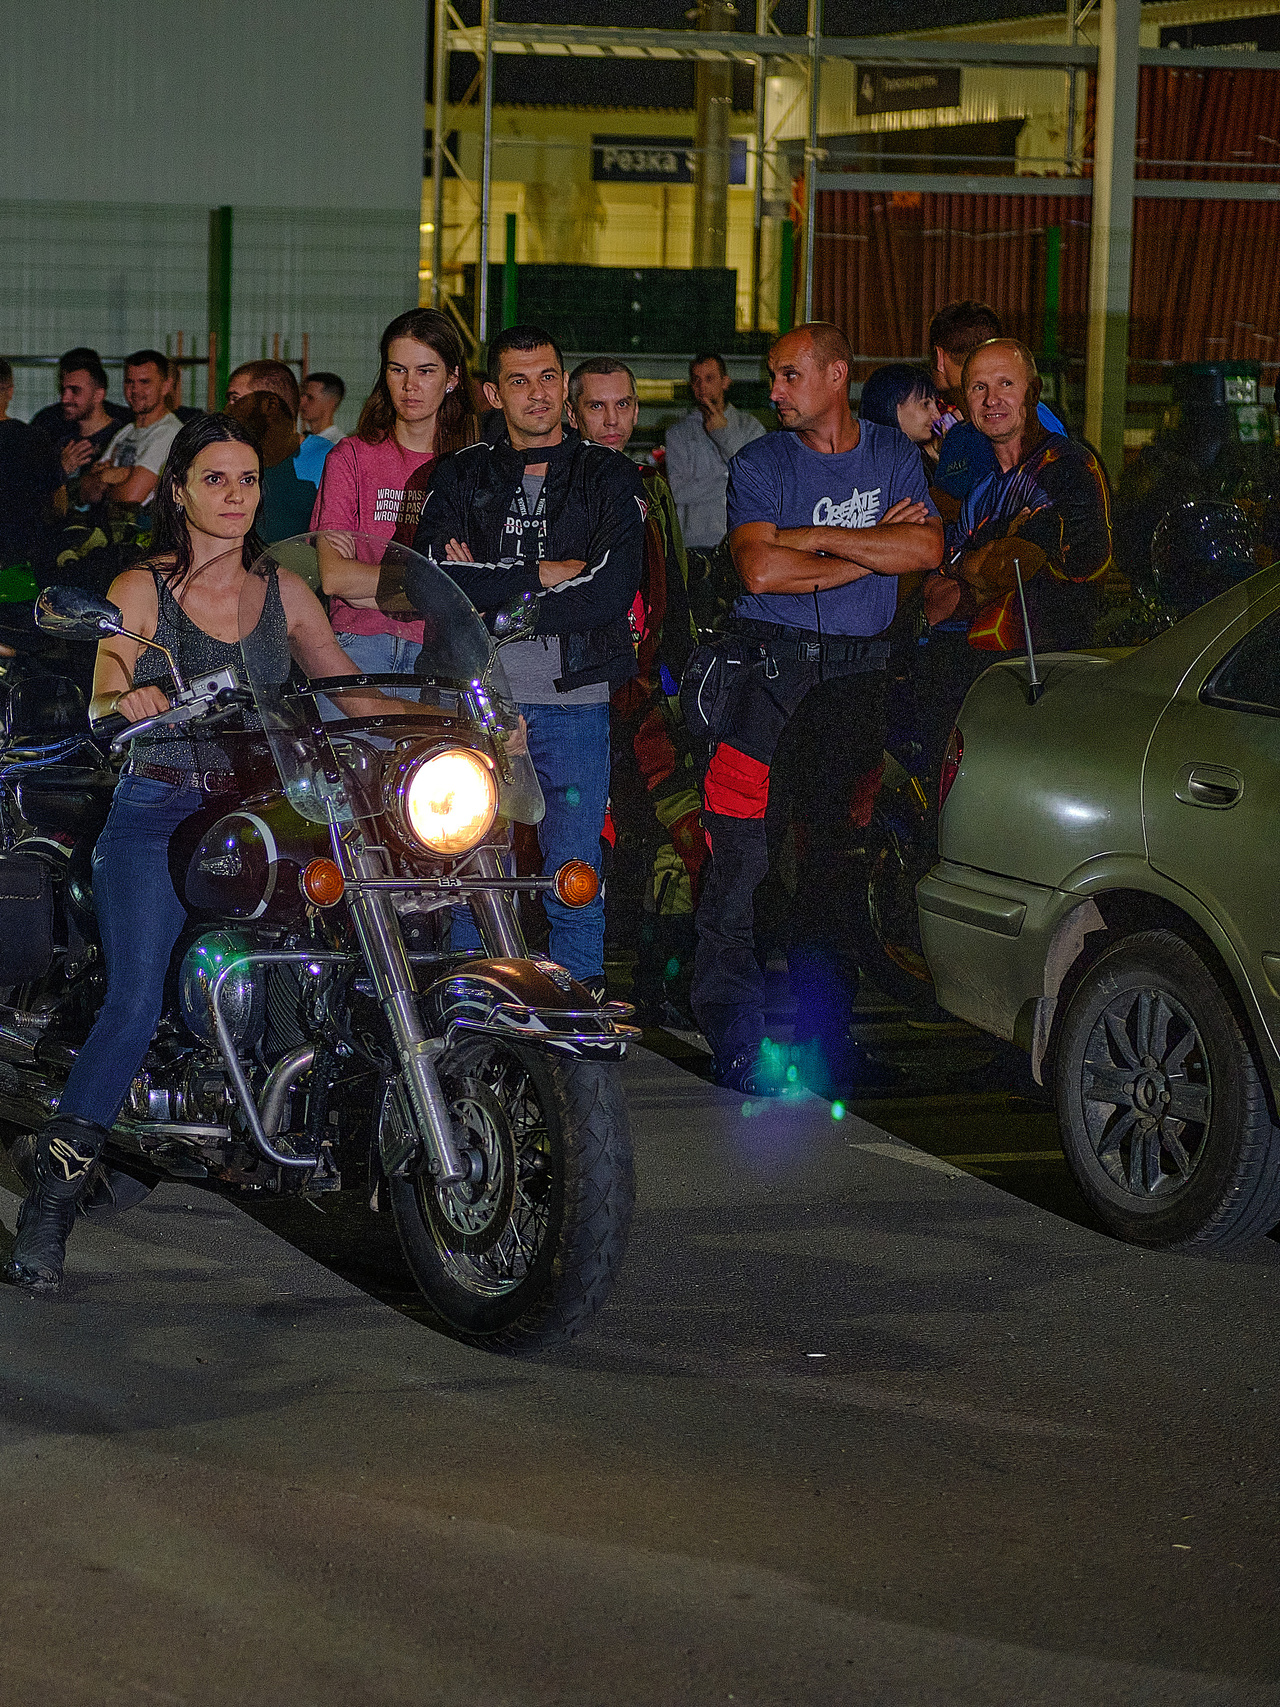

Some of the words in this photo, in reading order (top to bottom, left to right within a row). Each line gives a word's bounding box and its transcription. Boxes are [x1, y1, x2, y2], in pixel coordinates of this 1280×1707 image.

[377, 488, 406, 501] WRONG
[376, 500, 405, 512] WRONG
[406, 502, 422, 513] PAS
[374, 511, 404, 523] WRONG
[405, 513, 420, 525] PAS
